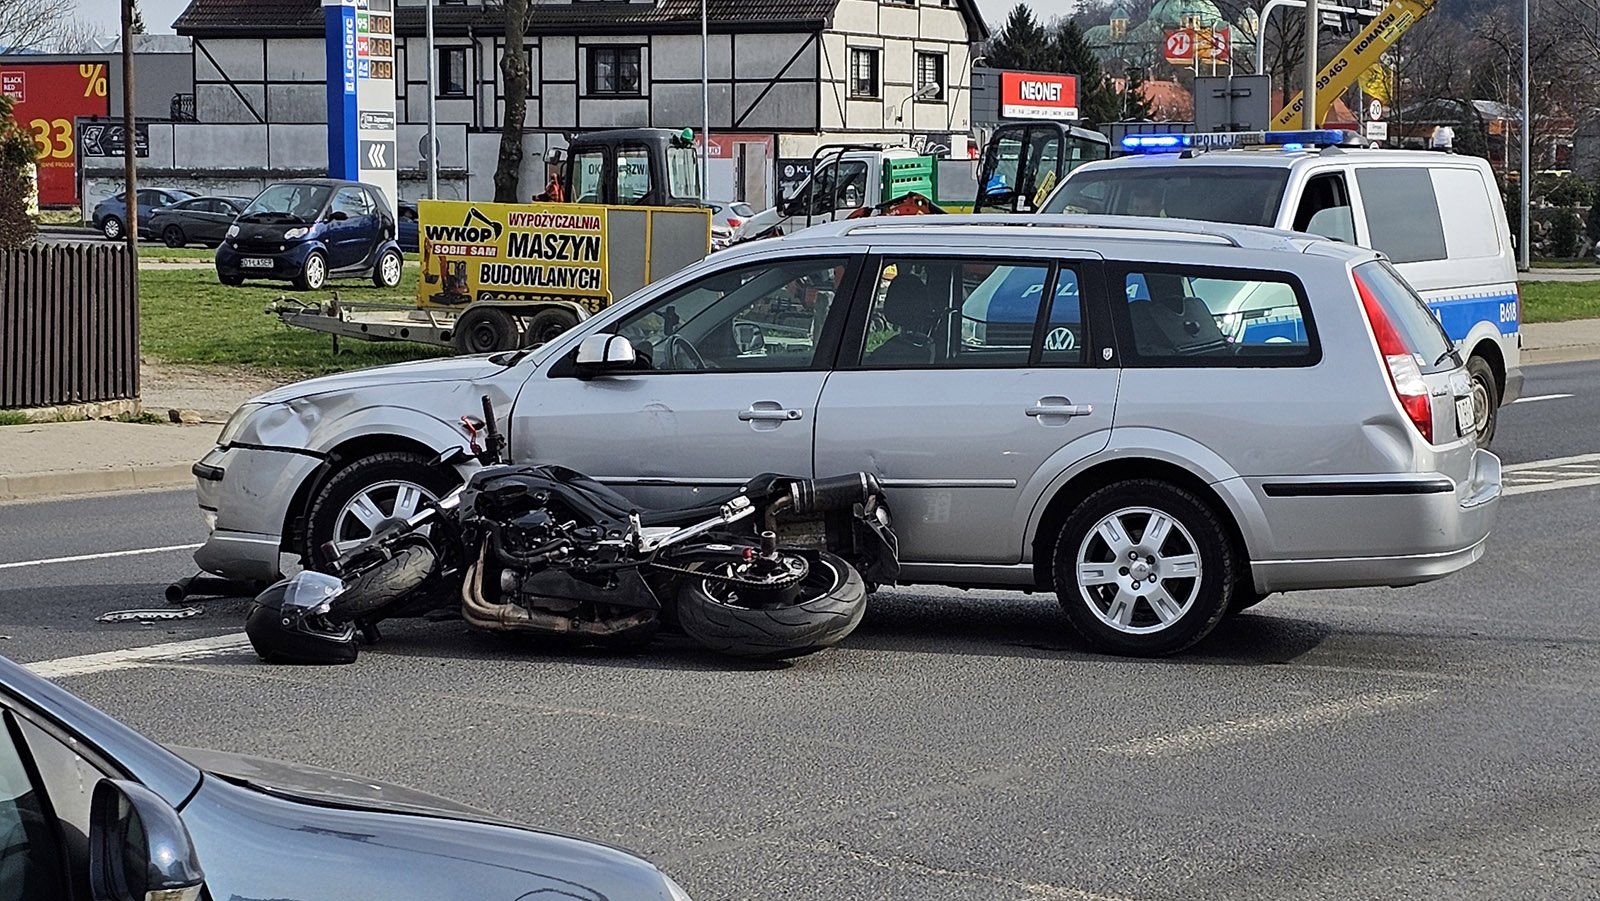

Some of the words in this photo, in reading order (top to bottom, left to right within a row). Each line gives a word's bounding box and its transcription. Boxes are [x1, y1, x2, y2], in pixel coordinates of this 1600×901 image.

[357, 18, 368, 29] 95
[1353, 13, 1395, 55] KOMATSU
[1328, 58, 1349, 79] 463
[1020, 80, 1062, 101] NEONET
[30, 118, 73, 159] 33
[508, 210, 600, 230] WYPOŻYCZALNIA
[425, 225, 492, 243] WYKOP
[434, 244, 467, 255] SOBIE
[470, 245, 497, 256] SAM
[506, 232, 600, 262] MASZYN
[480, 263, 600, 290] BUDOWLANYCH
[1499, 302, 1518, 323] B618
